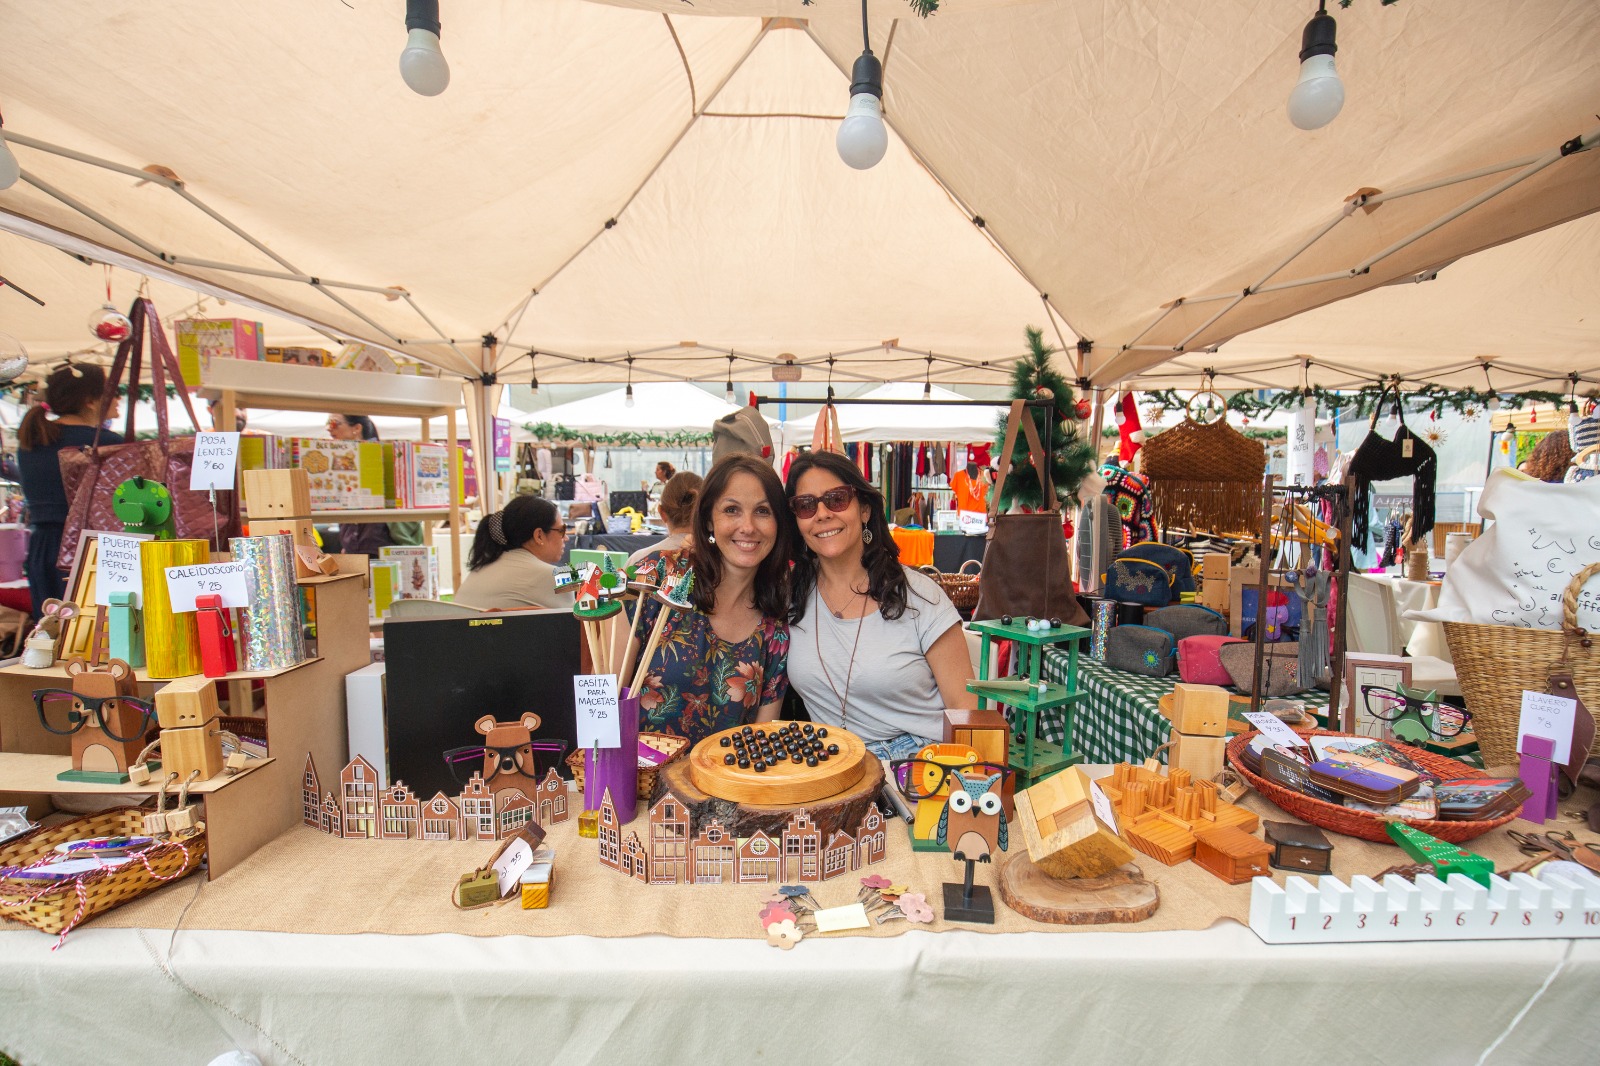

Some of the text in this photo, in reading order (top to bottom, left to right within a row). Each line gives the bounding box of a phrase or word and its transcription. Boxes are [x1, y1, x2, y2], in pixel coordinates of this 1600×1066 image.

[201, 435, 226, 445] POSA
[197, 447, 233, 457] LENTES
[103, 536, 140, 549] PUERTA
[578, 697, 617, 706] MACETAS
[1527, 694, 1567, 708] LLAVERO
[1530, 703, 1560, 715] CUERO
[1288, 910, 1600, 930] 1 2 3 4 5 6 7 8 9 10
